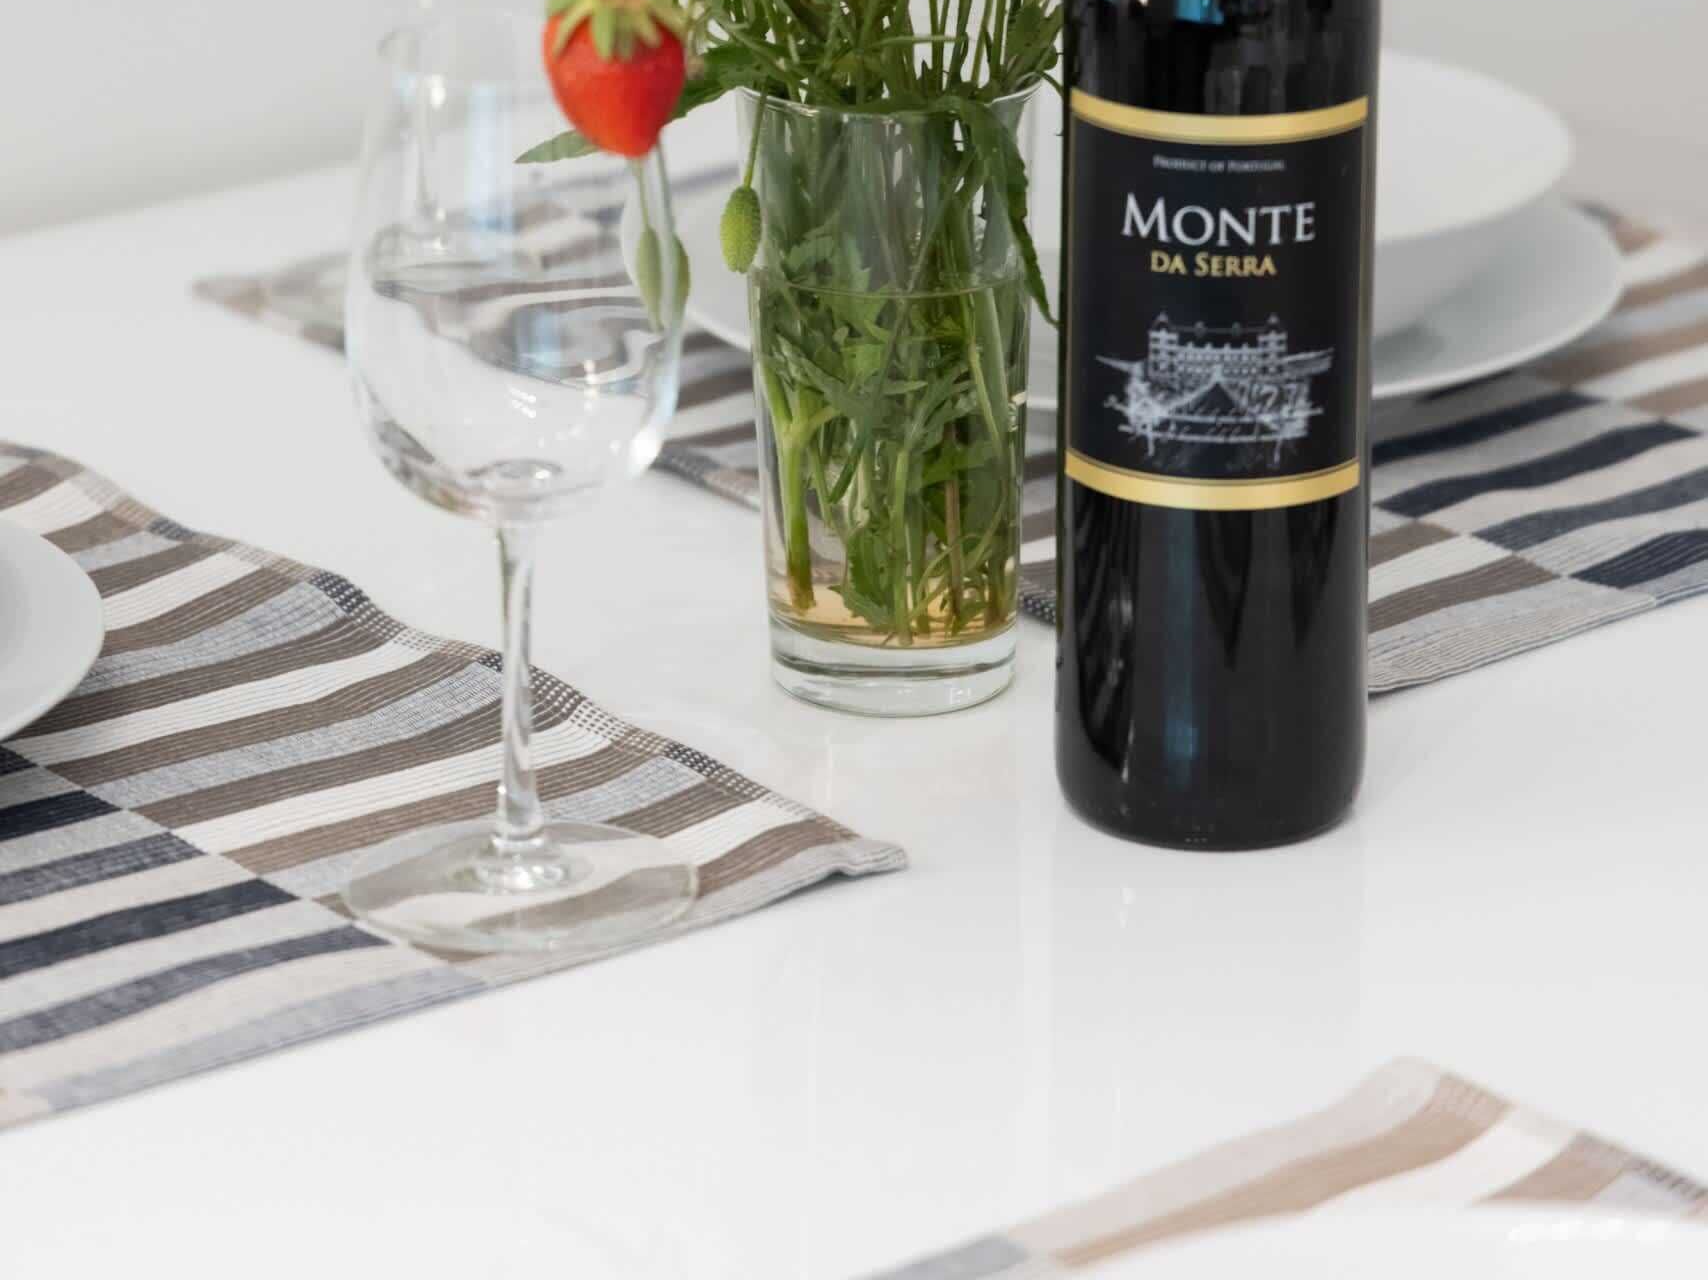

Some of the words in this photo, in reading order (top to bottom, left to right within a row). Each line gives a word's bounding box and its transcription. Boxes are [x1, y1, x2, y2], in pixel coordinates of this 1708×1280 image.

[1121, 192, 1316, 247] MONTE
[1150, 250, 1188, 275] DA
[1194, 251, 1277, 278] SERRA
